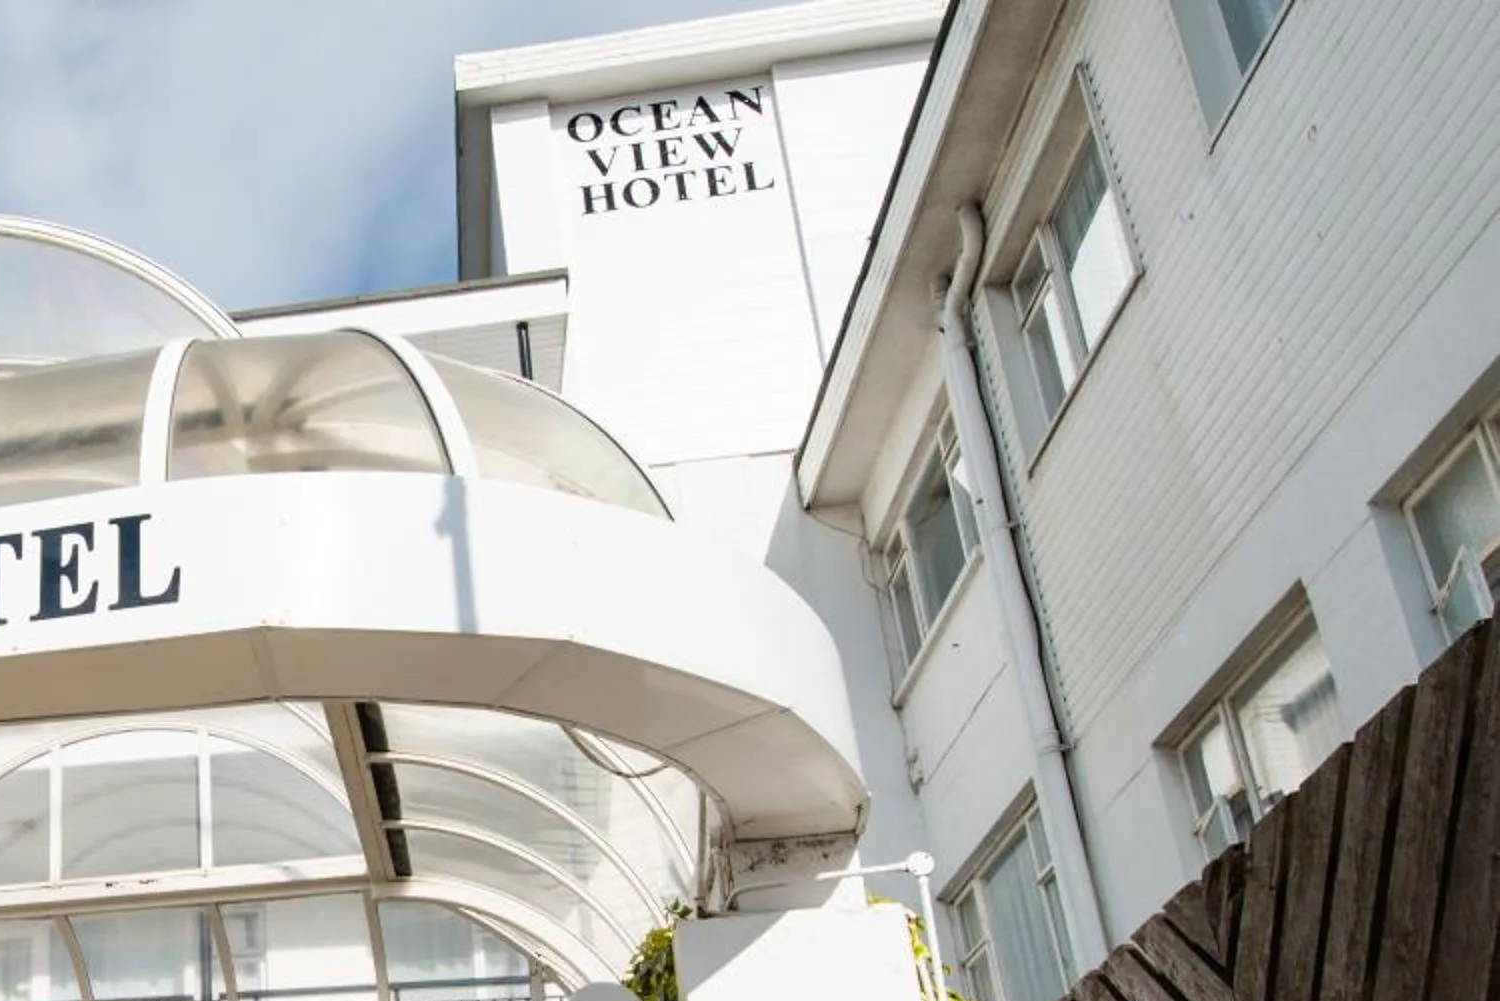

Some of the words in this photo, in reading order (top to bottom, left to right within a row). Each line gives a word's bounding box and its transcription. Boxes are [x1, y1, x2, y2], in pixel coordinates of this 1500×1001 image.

[567, 85, 765, 143] OCEAN
[585, 127, 743, 177] VIEW
[580, 161, 775, 216] HOTEL
